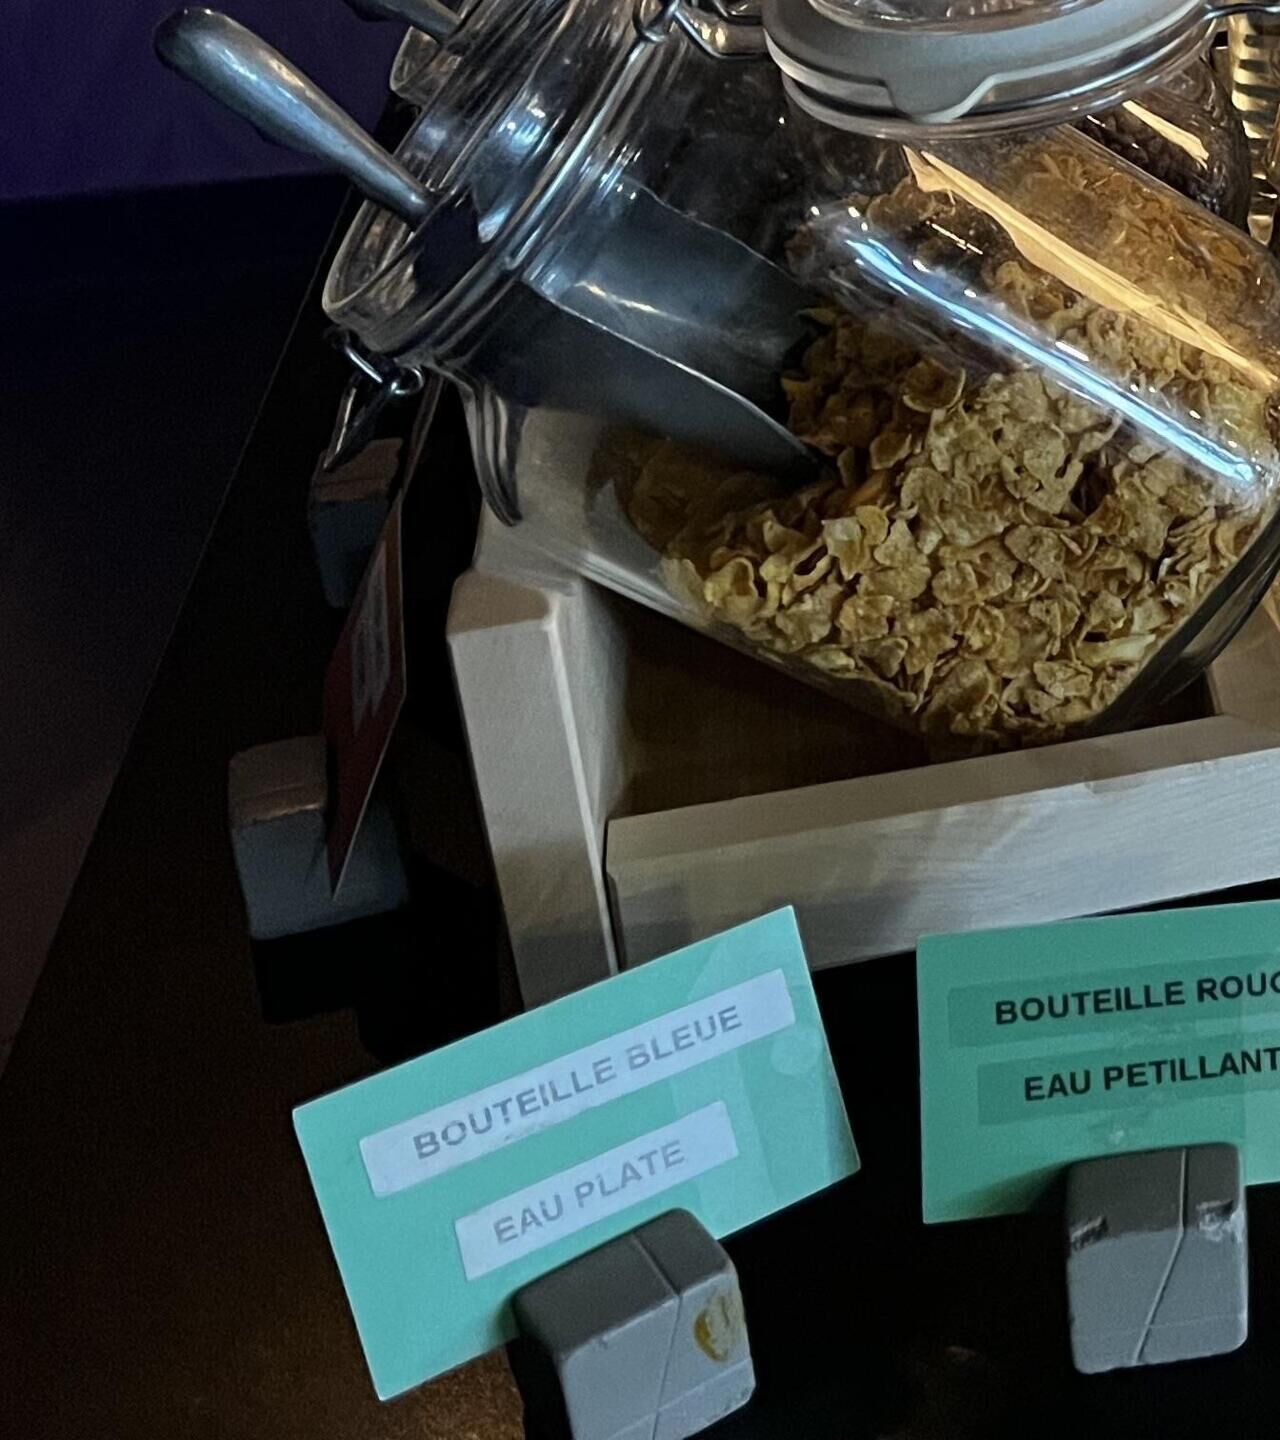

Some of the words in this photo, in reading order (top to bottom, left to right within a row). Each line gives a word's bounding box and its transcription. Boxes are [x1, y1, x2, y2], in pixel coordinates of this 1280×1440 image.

[995, 981, 1186, 1025] BOUTEILLE
[413, 1056, 617, 1160] BOUTEILLE
[625, 1005, 743, 1071] BLEUE
[1024, 1070, 1091, 1102] EAU
[492, 1193, 563, 1245] EAU
[573, 1139, 686, 1208] PLATE
